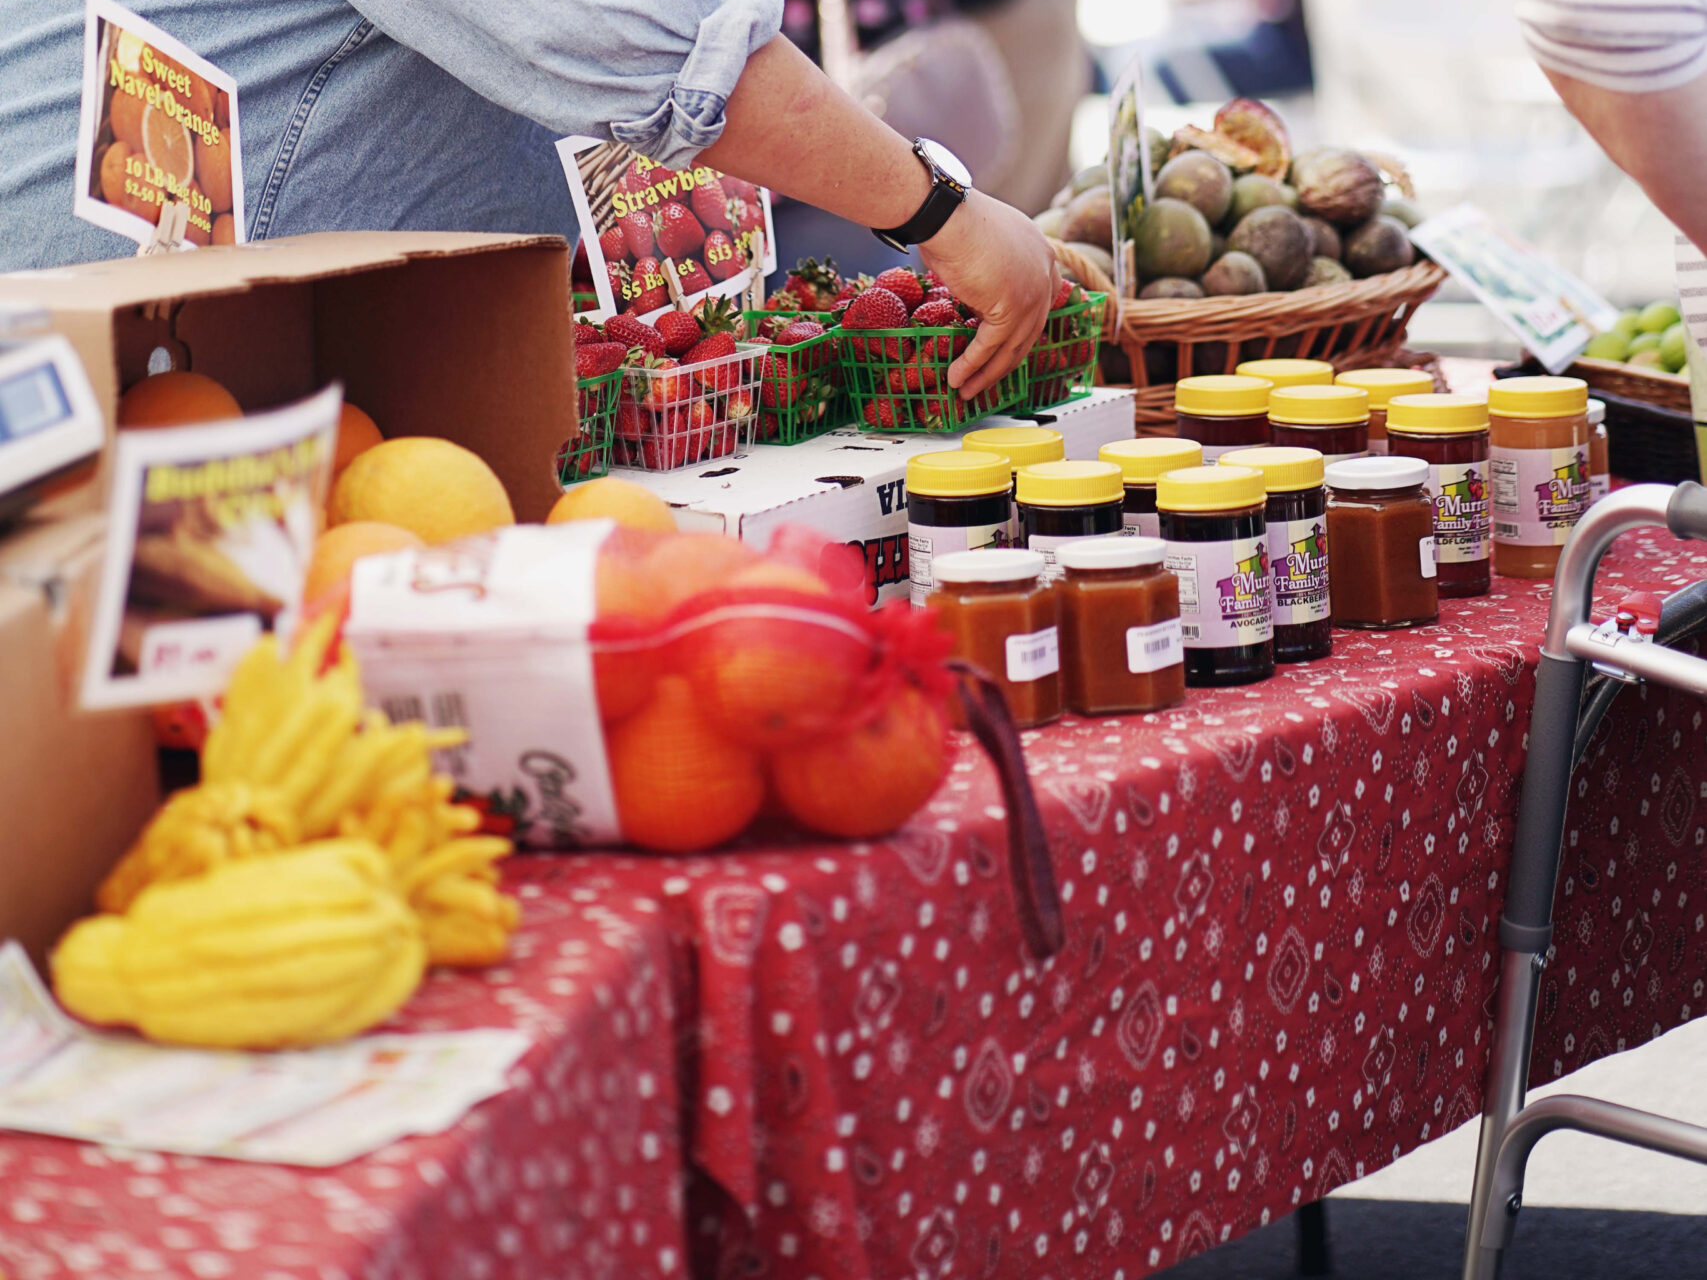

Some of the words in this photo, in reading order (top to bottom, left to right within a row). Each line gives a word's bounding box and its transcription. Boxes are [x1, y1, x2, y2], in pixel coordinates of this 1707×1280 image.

[142, 46, 192, 98] Sweet
[109, 58, 162, 110] Navel
[163, 90, 220, 146] Orange
[125, 156, 143, 178] 10
[144, 163, 164, 188] LB
[166, 172, 190, 207] Bag
[191, 188, 212, 215] $10
[125, 178, 155, 203] $2.50
[611, 165, 725, 218] Strawber
[708, 243, 733, 266] $13
[621, 280, 643, 301] $5
[643, 257, 696, 292] Baet
[1274, 574, 1320, 592] Family
[1219, 593, 1265, 613] Family
[1230, 615, 1269, 629] AVOCADO
